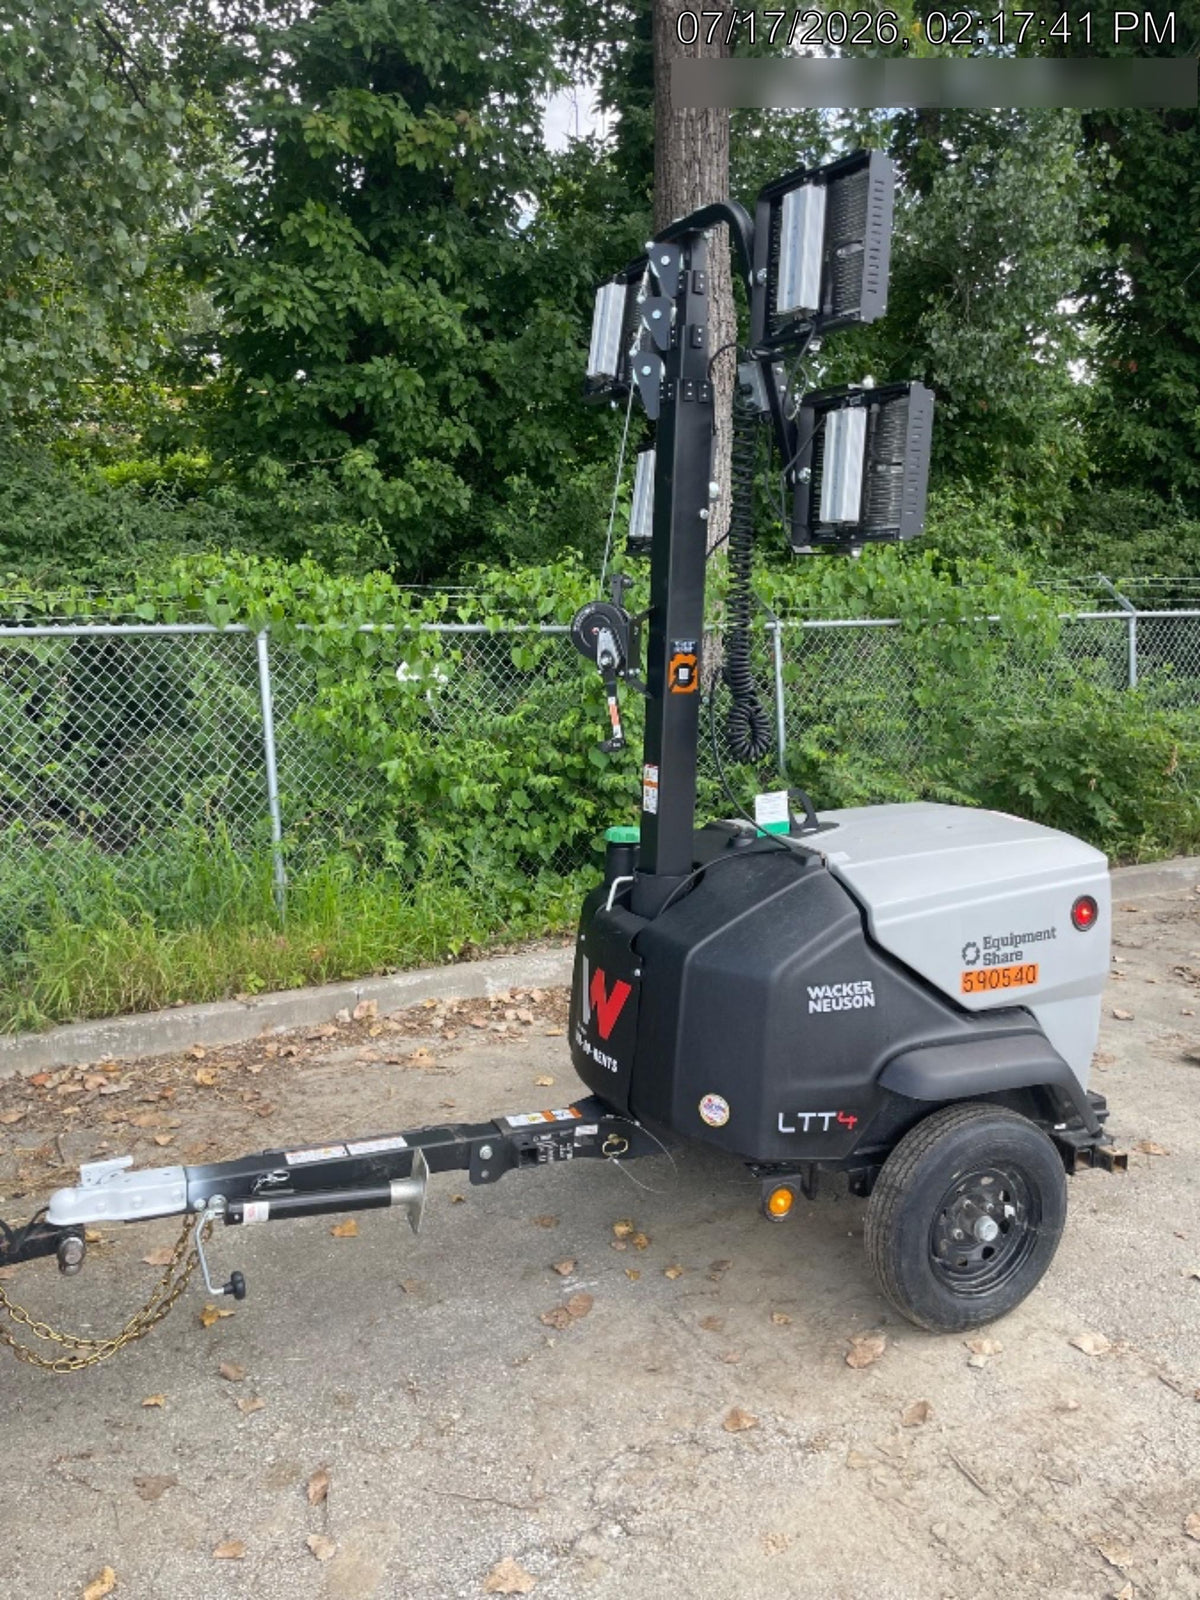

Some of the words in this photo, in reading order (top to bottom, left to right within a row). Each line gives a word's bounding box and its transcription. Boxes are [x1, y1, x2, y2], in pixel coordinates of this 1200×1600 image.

[982, 926, 1057, 951] Equipment
[982, 950, 1024, 966] Share
[962, 964, 1037, 993] 590540
[806, 980, 875, 1000] WACKER
[808, 993, 876, 1014] NEUSON
[777, 1110, 858, 1134] LTT4
